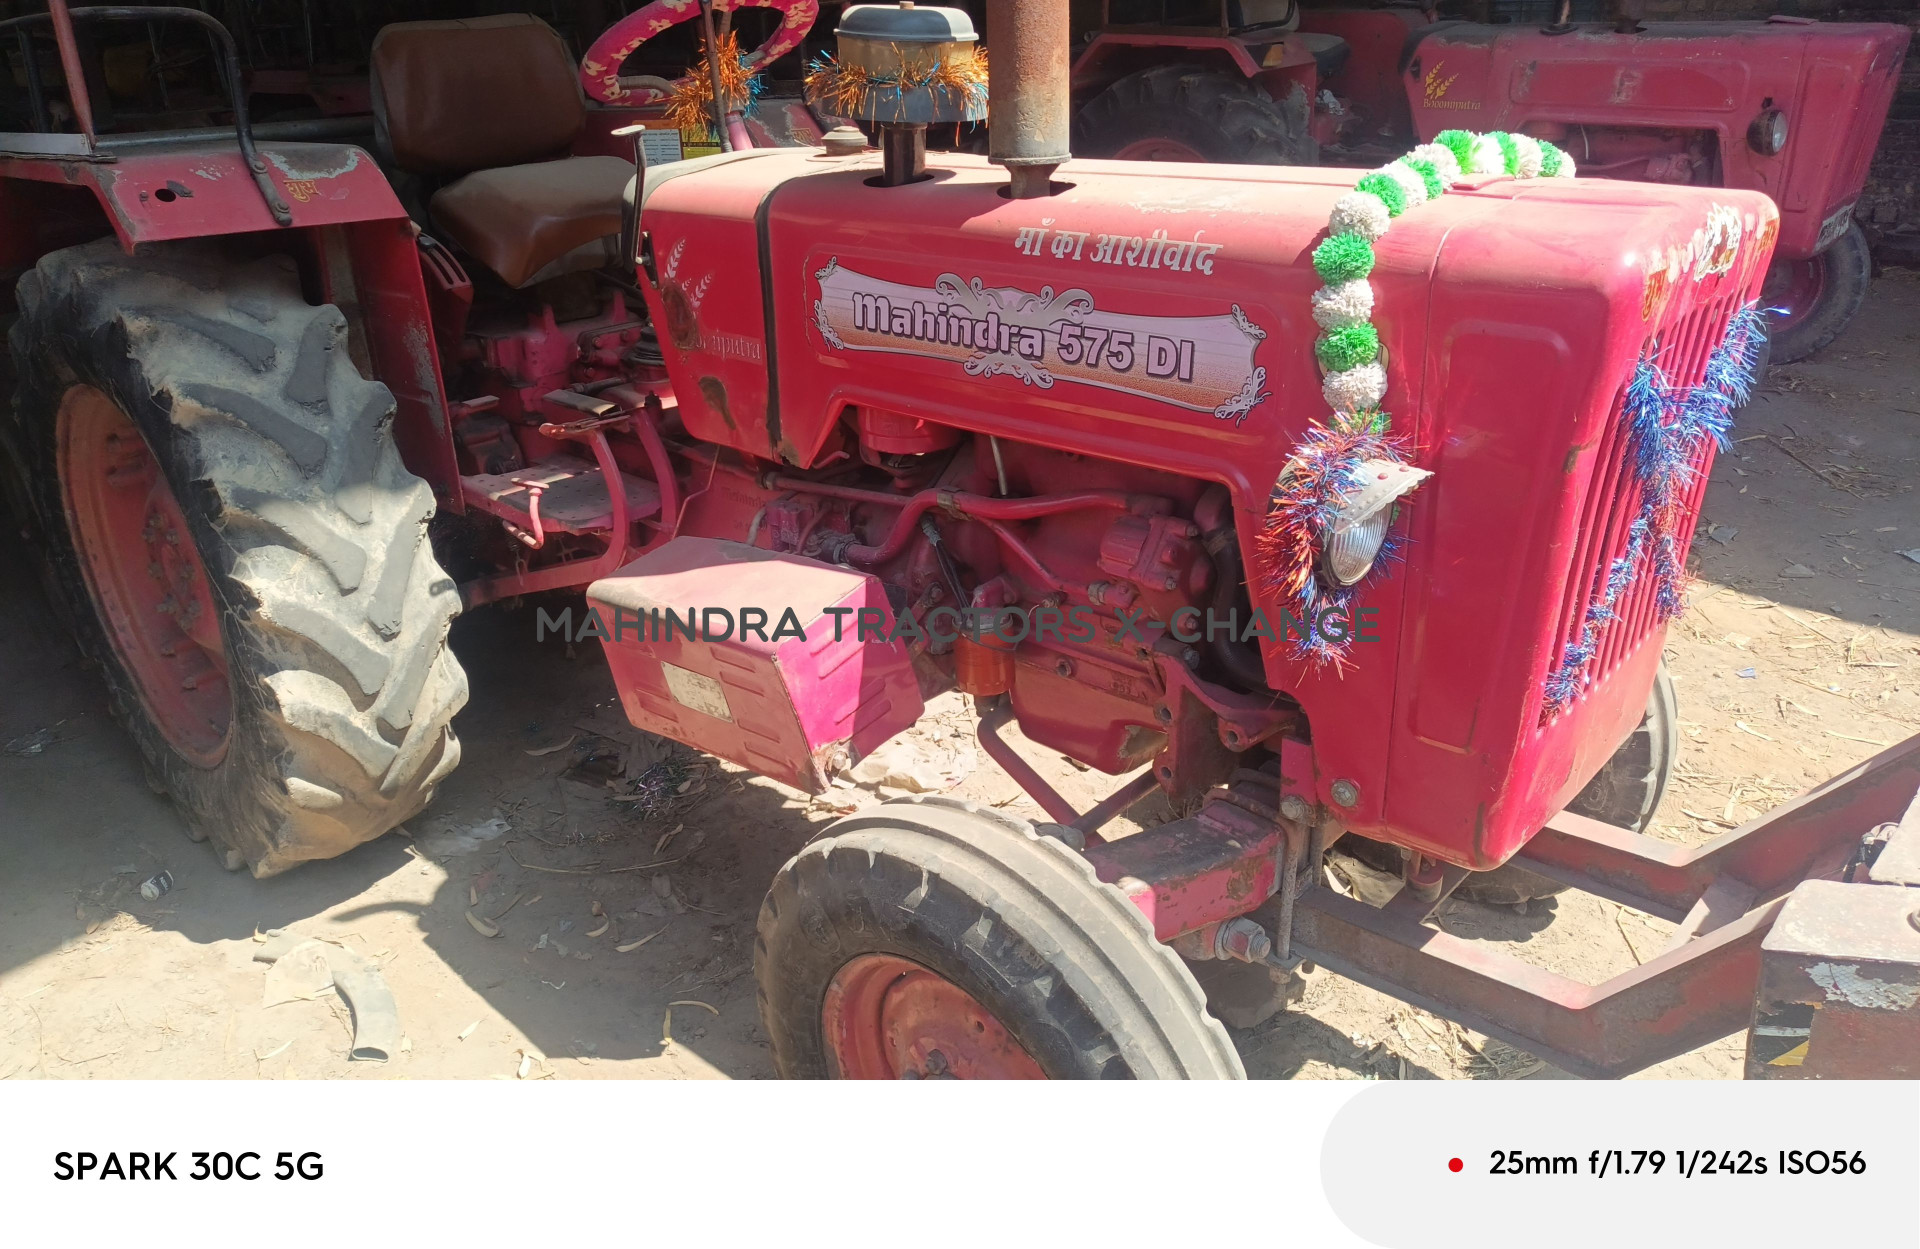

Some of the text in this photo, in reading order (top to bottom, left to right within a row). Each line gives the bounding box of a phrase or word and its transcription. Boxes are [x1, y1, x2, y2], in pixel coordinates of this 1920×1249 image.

[1014, 217, 1223, 276] माँ का आशीर्वाद
[852, 292, 1195, 380] Mahindra 575 DI
